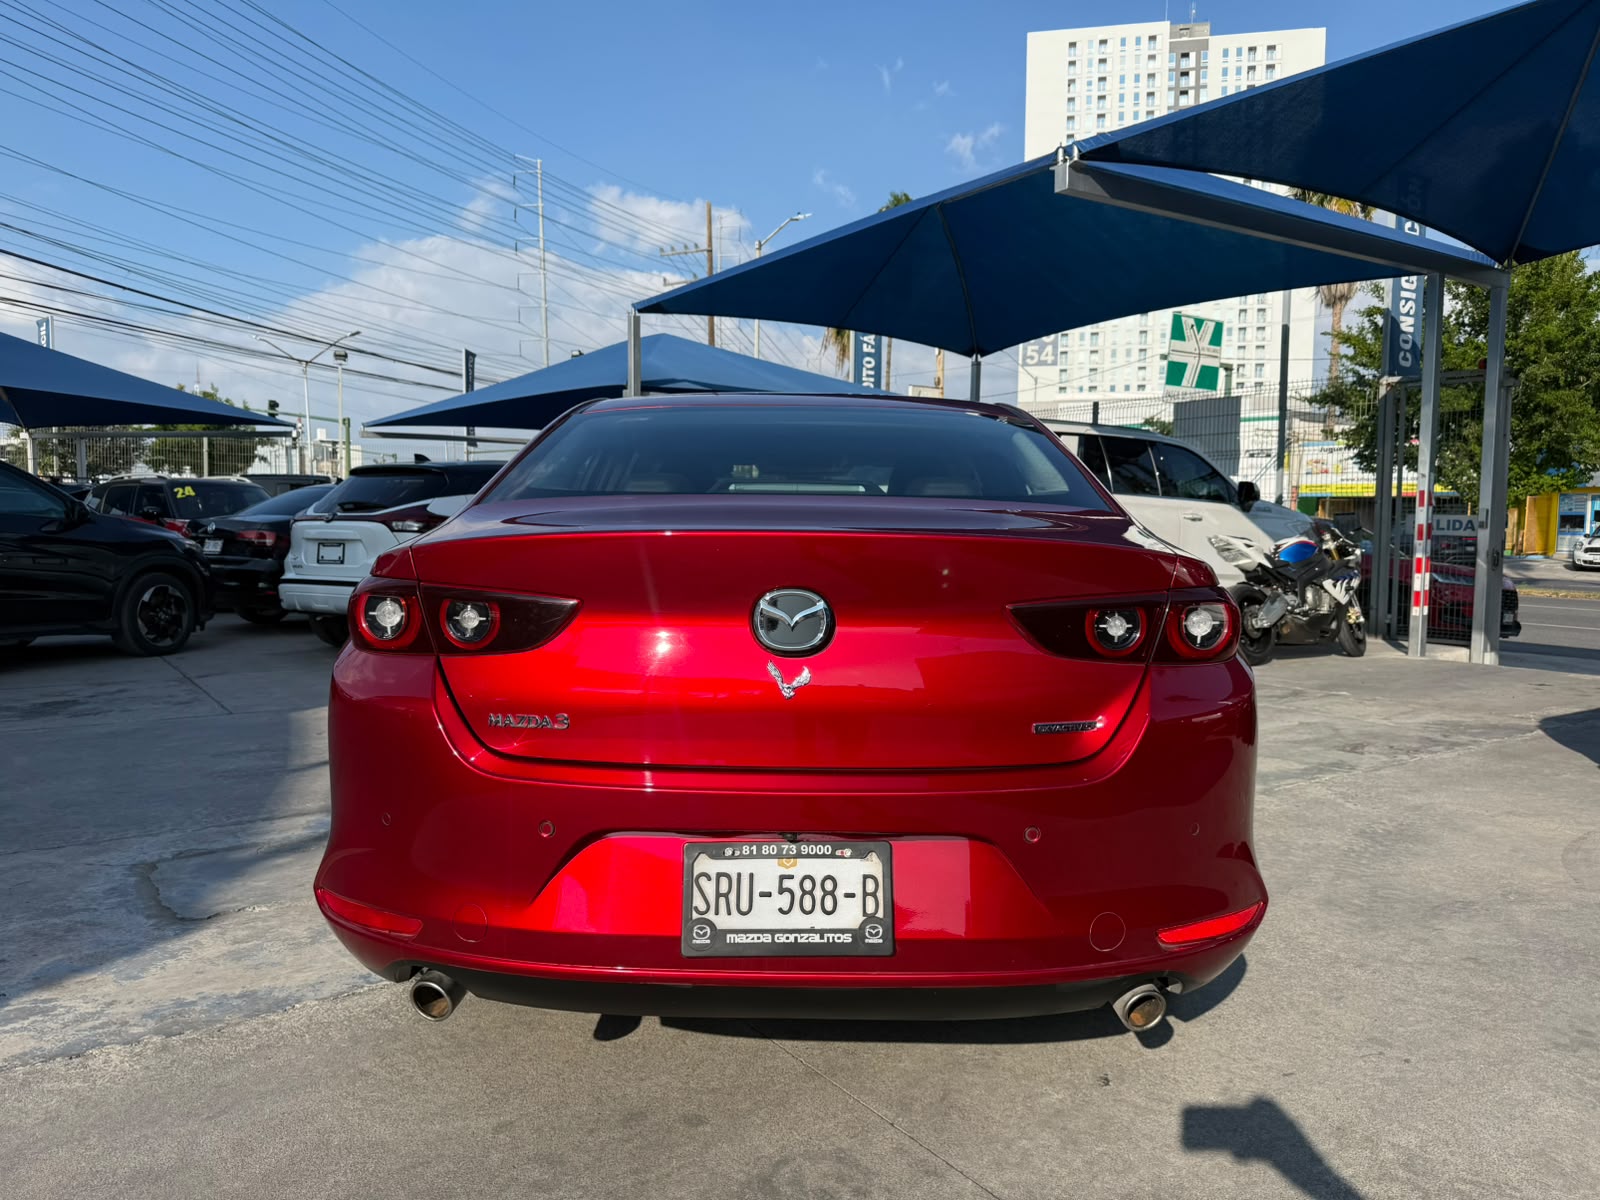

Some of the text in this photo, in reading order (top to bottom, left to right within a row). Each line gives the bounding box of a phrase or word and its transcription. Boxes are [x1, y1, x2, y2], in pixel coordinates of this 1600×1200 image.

[1026, 345, 1055, 365] 54
[173, 486, 196, 499] 24
[1431, 519, 1476, 532] LIDA
[742, 844, 832, 855] 81 80 73 9000
[693, 872, 880, 918] SRU-588-B
